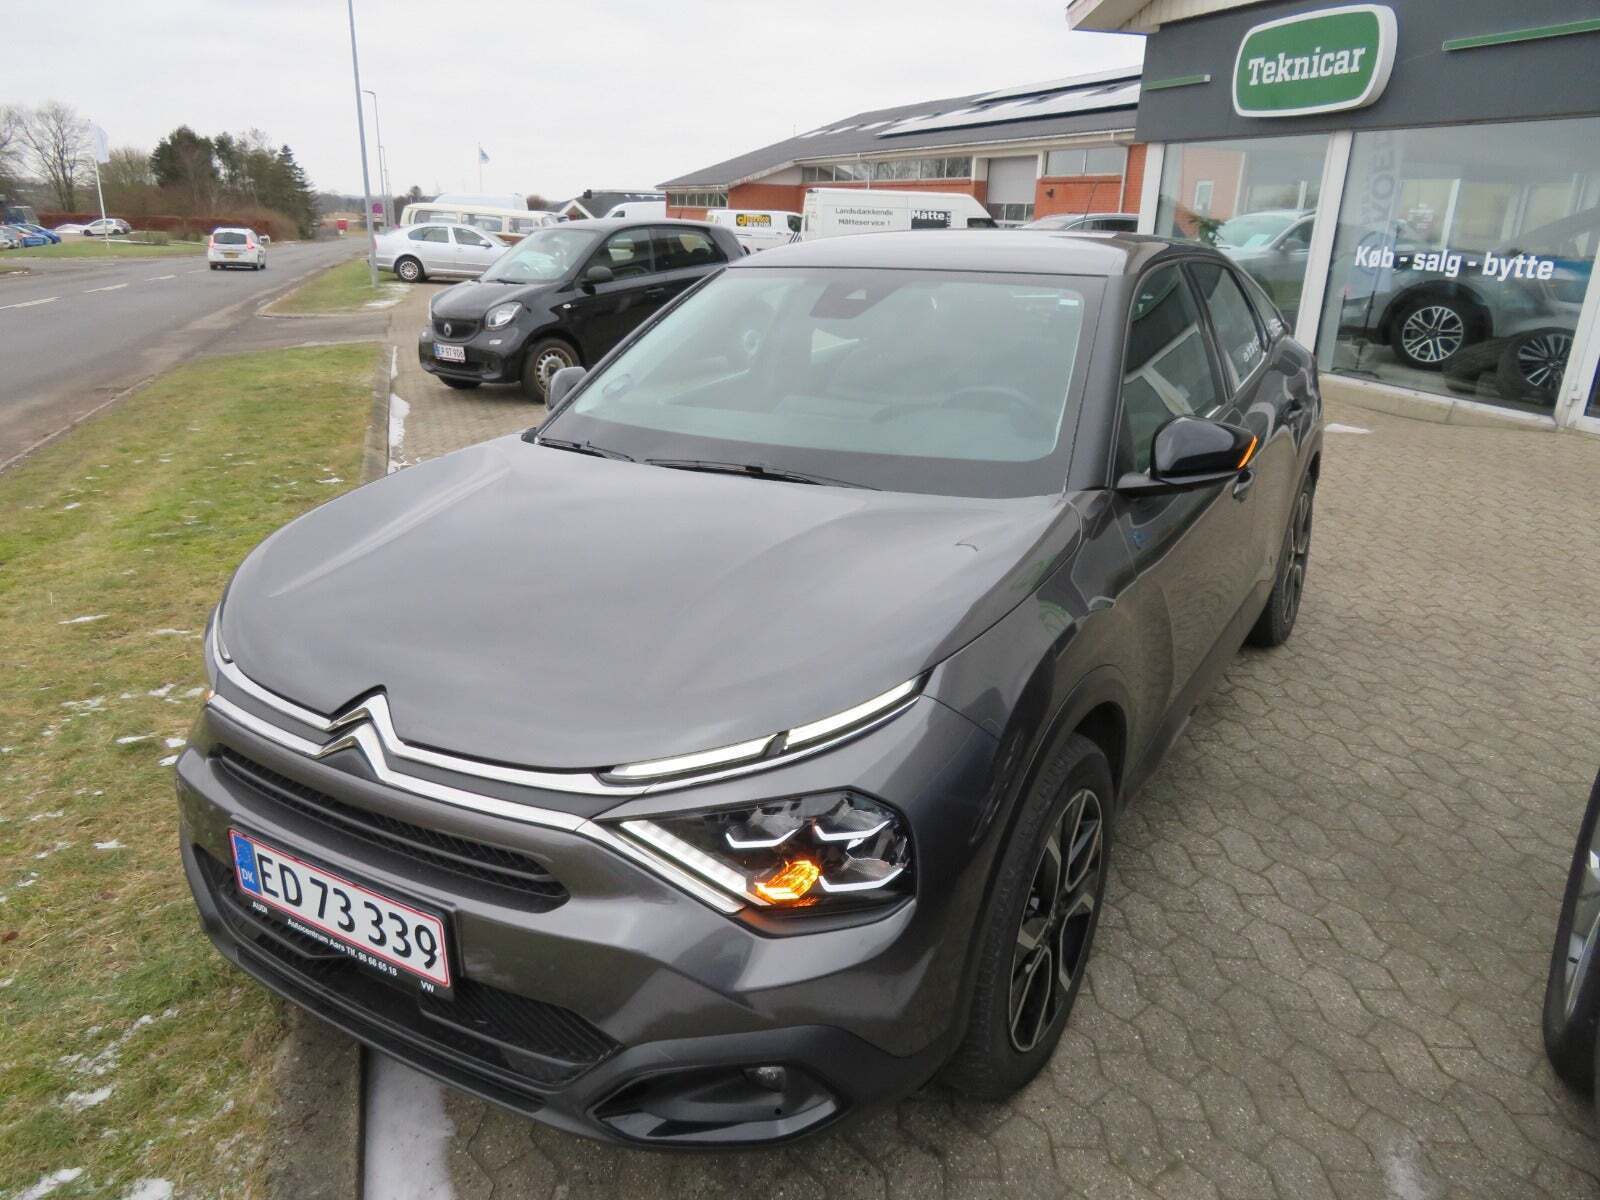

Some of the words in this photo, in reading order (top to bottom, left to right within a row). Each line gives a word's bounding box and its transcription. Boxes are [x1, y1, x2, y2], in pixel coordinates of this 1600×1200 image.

[1248, 46, 1367, 86] Teknicar
[1355, 245, 1395, 268] Køb
[1412, 249, 1462, 278] salg
[1482, 252, 1554, 281] bytte
[241, 868, 254, 884] DK
[257, 853, 303, 907] ED
[309, 876, 356, 932] 73
[363, 900, 438, 970] 339
[420, 980, 434, 993] VW
